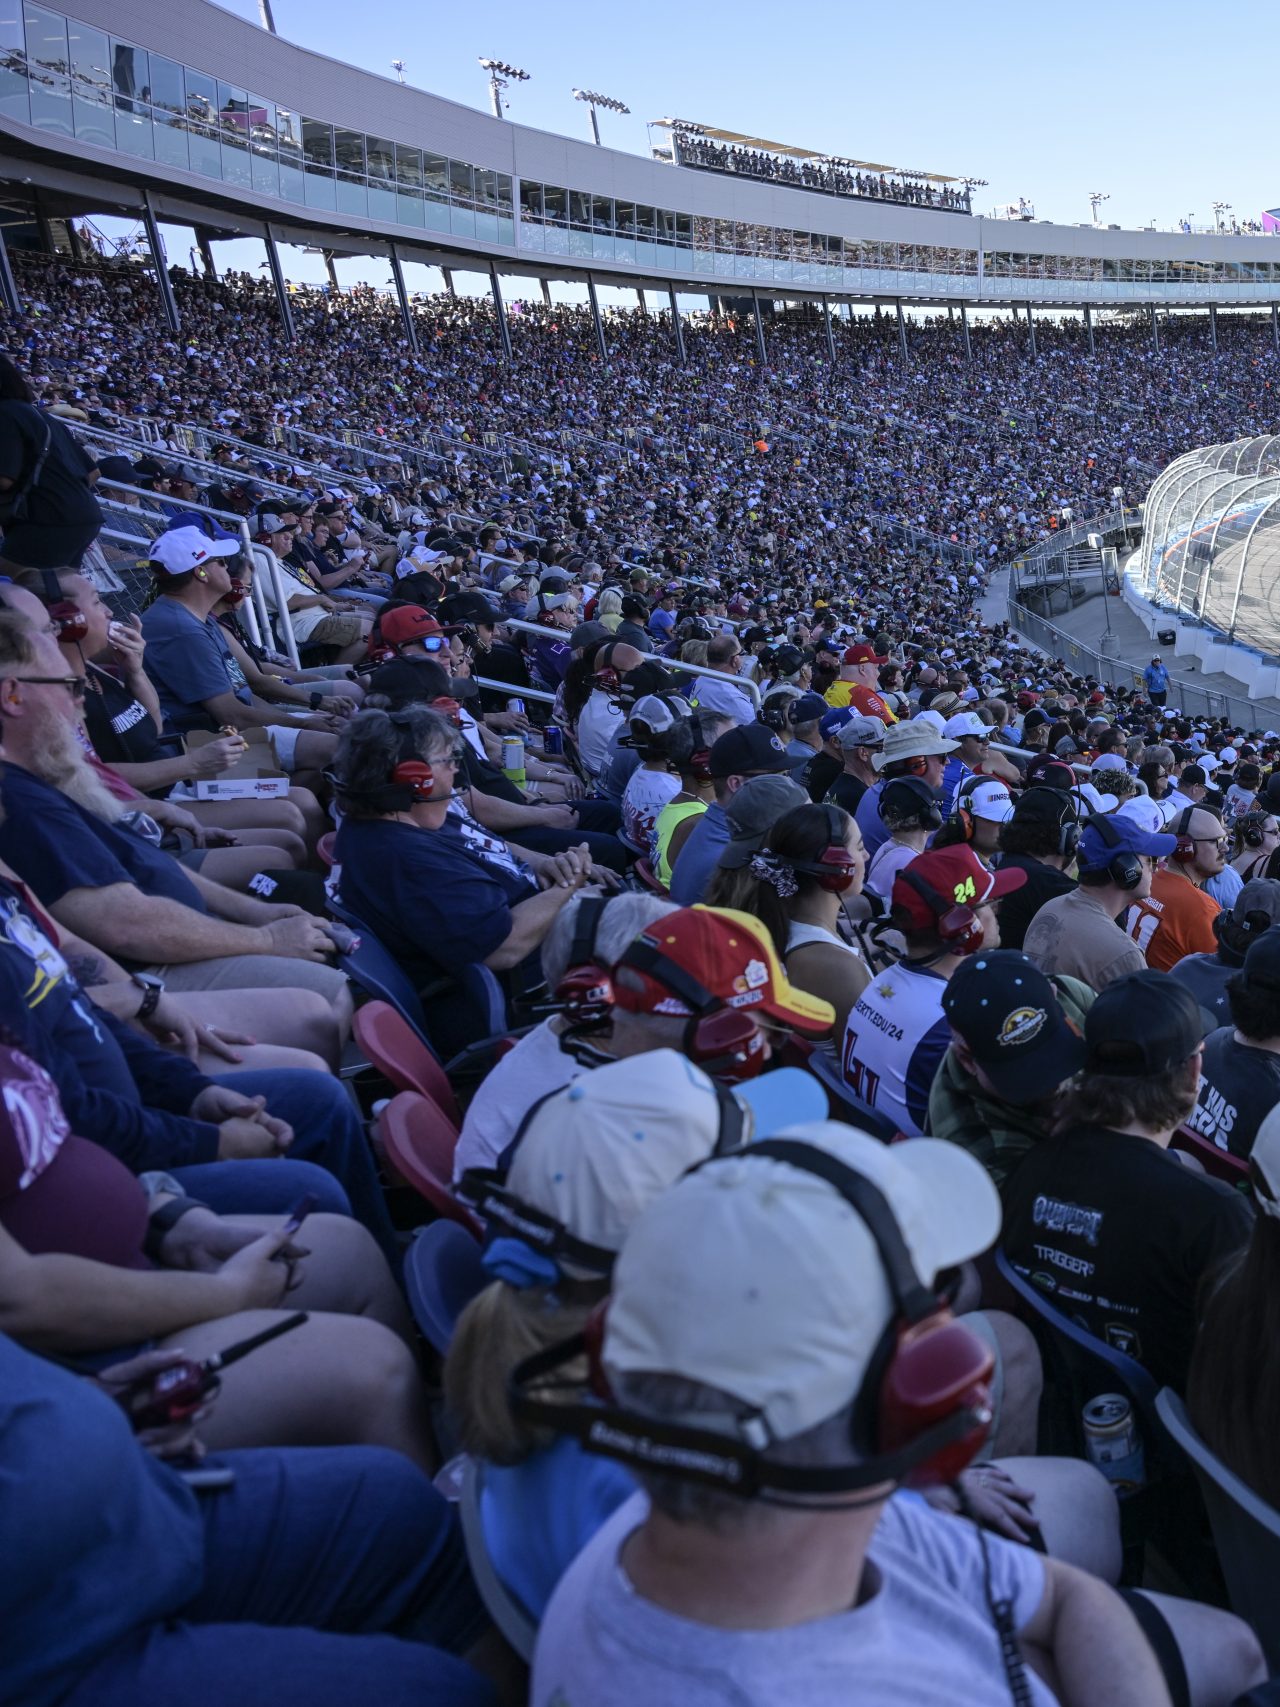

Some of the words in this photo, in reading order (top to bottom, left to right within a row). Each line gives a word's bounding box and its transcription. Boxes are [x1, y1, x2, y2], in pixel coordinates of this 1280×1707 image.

[953, 875, 976, 904] 24
[1205, 1086, 1238, 1133] HAS
[1034, 1244, 1089, 1277] TRIGGER
